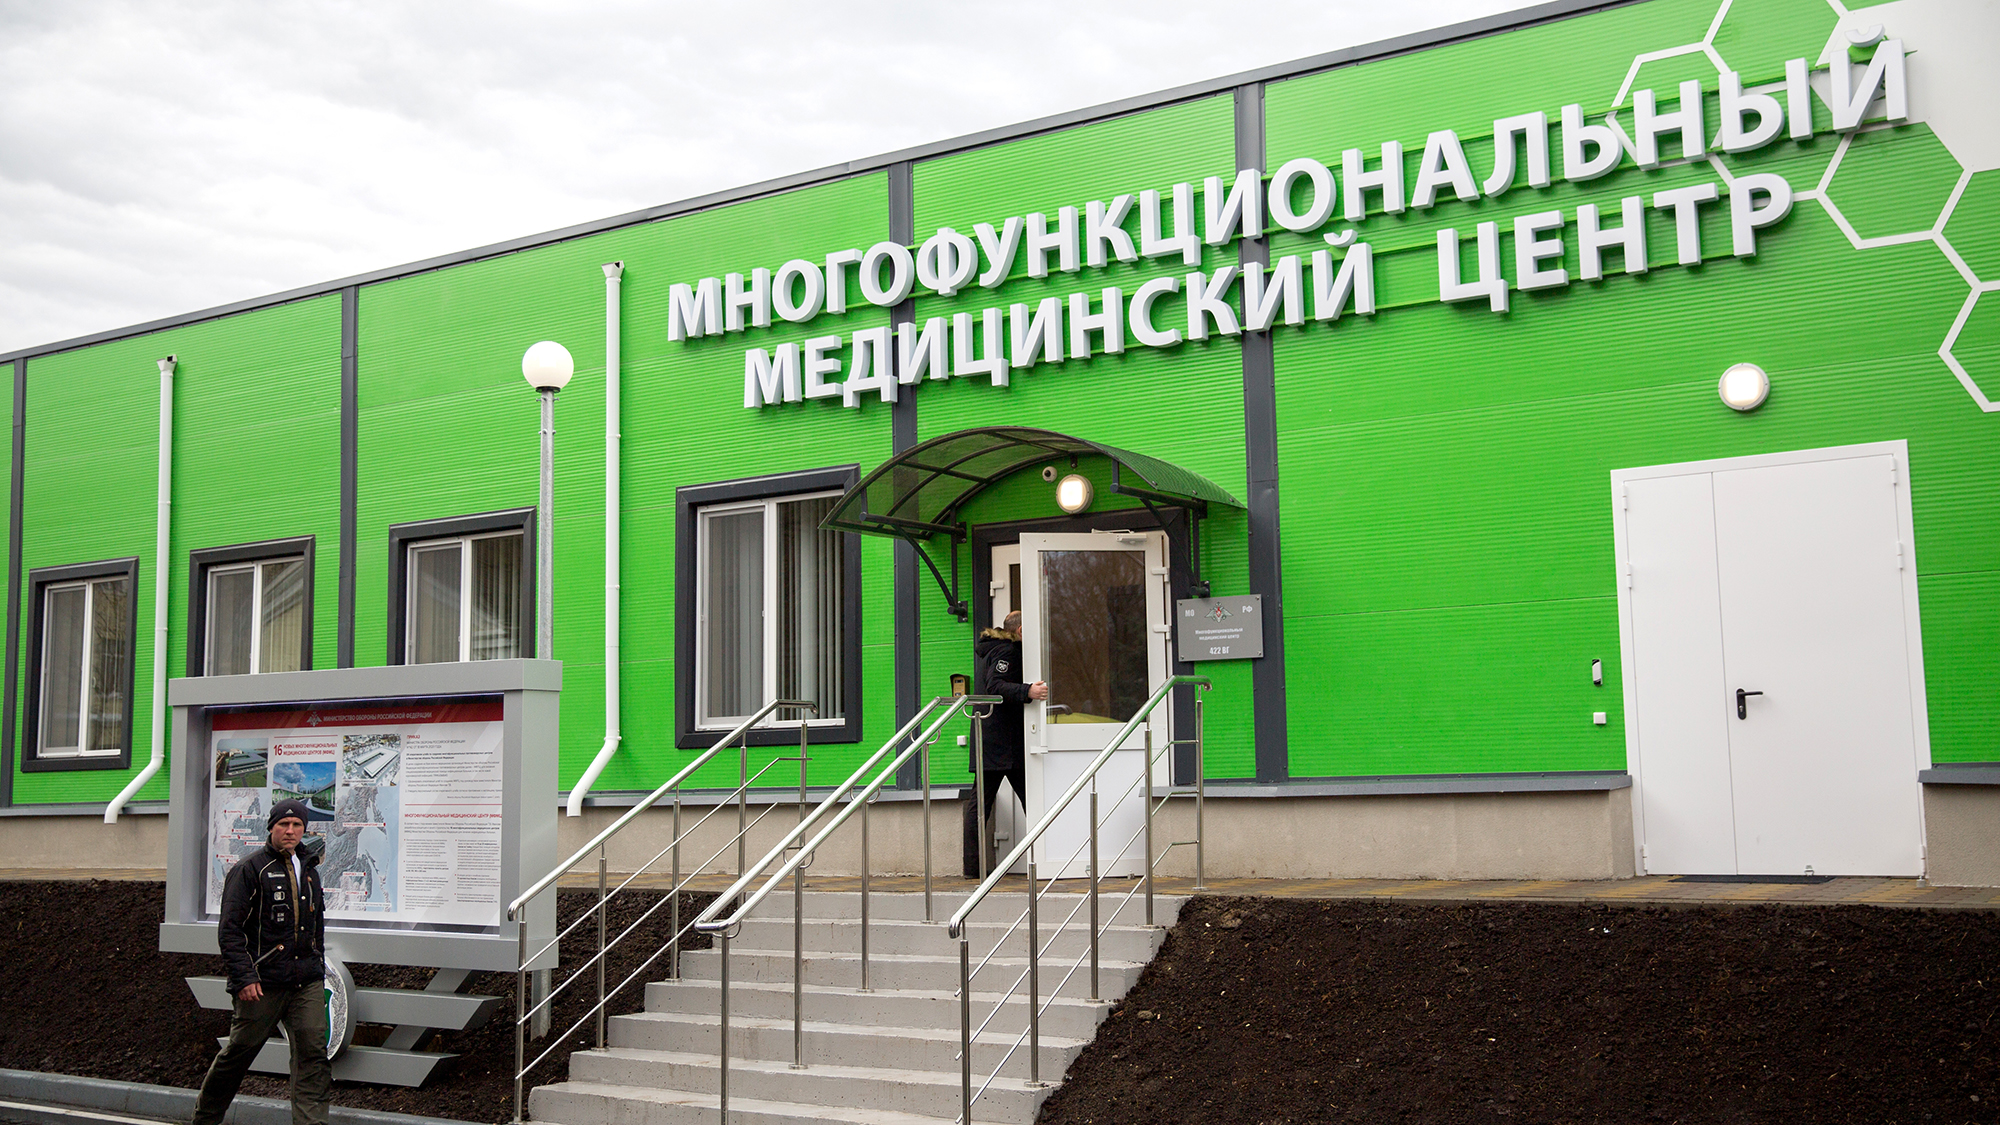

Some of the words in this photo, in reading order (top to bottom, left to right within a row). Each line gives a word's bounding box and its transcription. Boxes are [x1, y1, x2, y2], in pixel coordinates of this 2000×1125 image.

[667, 24, 1909, 342] МНОГОФУНКЦИОНАЛЬНЫЙ
[743, 229, 1375, 409] МЕДИЦИНСКИЙ
[1436, 173, 1794, 314] ЦЕНТР
[1185, 609, 1195, 617] МО
[1242, 605, 1253, 613] РФ
[1209, 646, 1221, 655] 422
[1222, 646, 1230, 654] ВГ
[273, 744, 283, 756] 16
